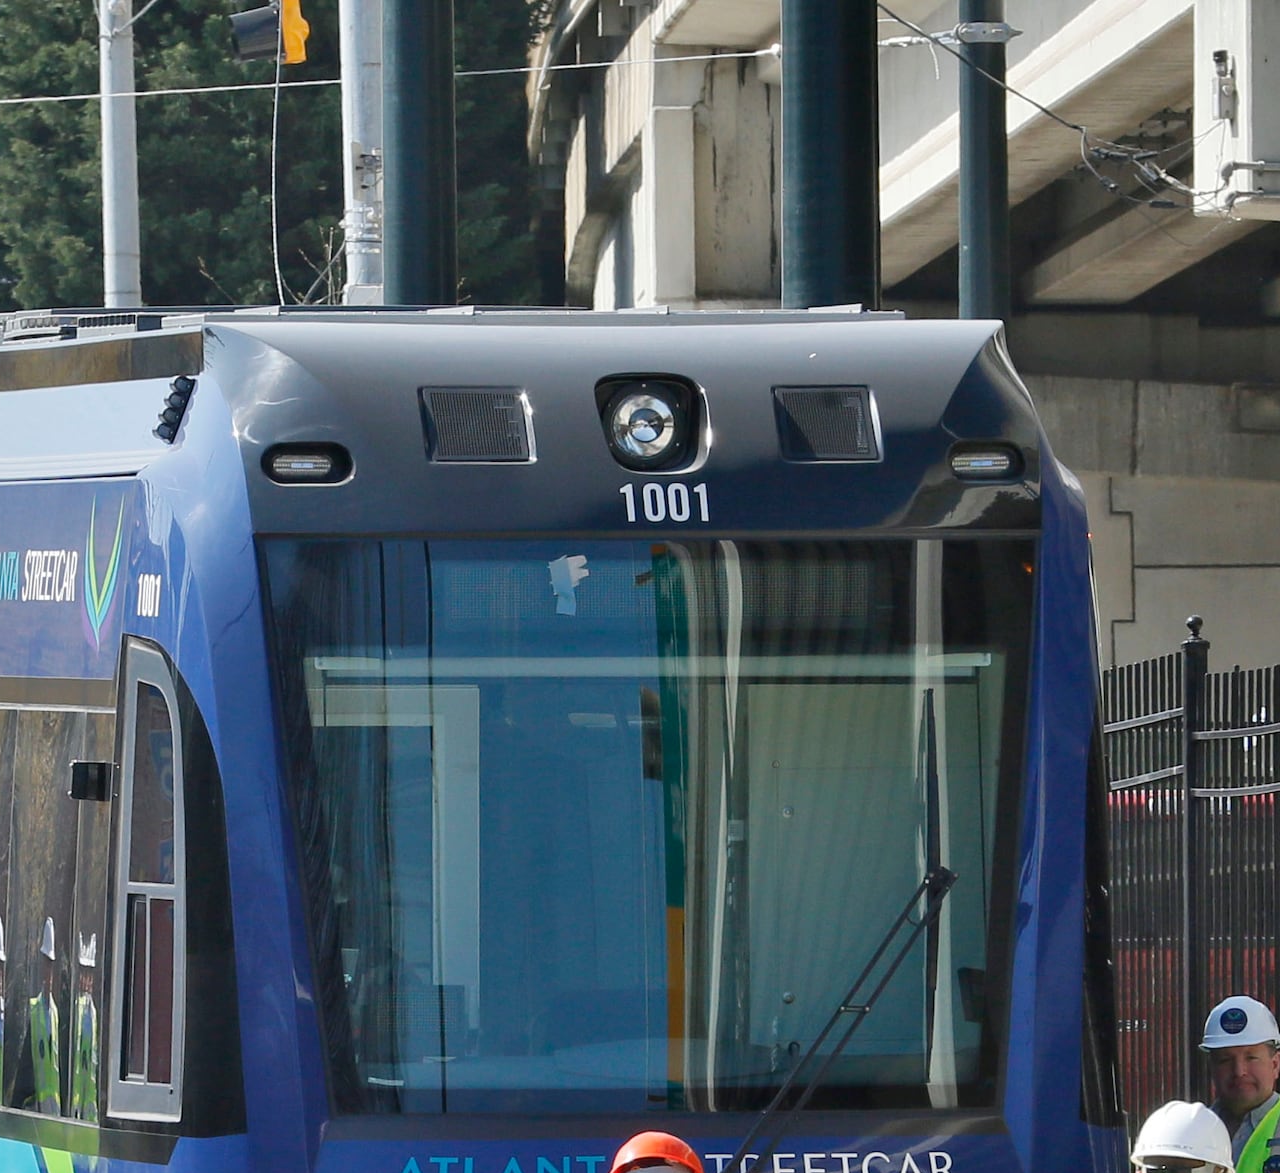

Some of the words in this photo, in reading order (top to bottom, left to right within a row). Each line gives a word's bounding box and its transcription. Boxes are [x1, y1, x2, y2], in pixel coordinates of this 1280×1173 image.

[618, 482, 710, 523] 1001
[21, 549, 78, 602] STREETCAR
[136, 573, 162, 617] 1001
